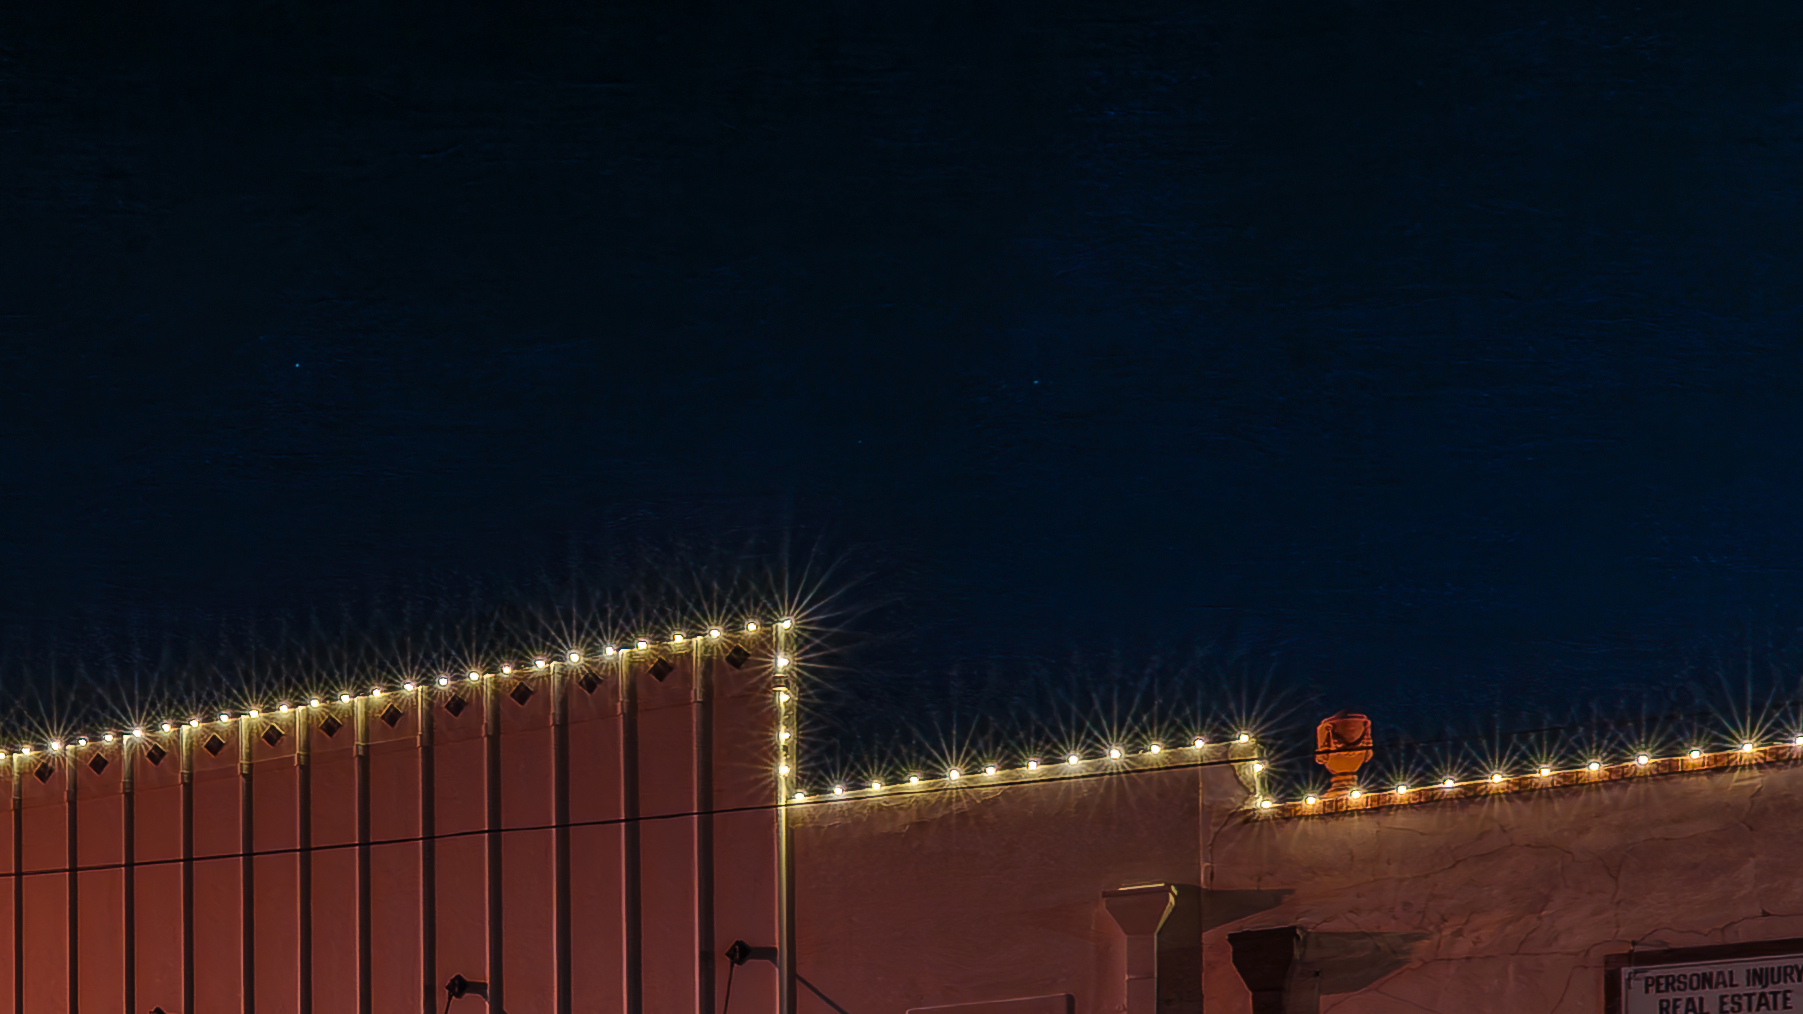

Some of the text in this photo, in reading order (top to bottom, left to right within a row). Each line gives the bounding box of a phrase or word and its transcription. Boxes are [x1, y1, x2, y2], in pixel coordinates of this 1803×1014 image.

[1644, 964, 1803, 995] PERSONAL INJURY
[1718, 989, 1794, 1014] ESTATE
